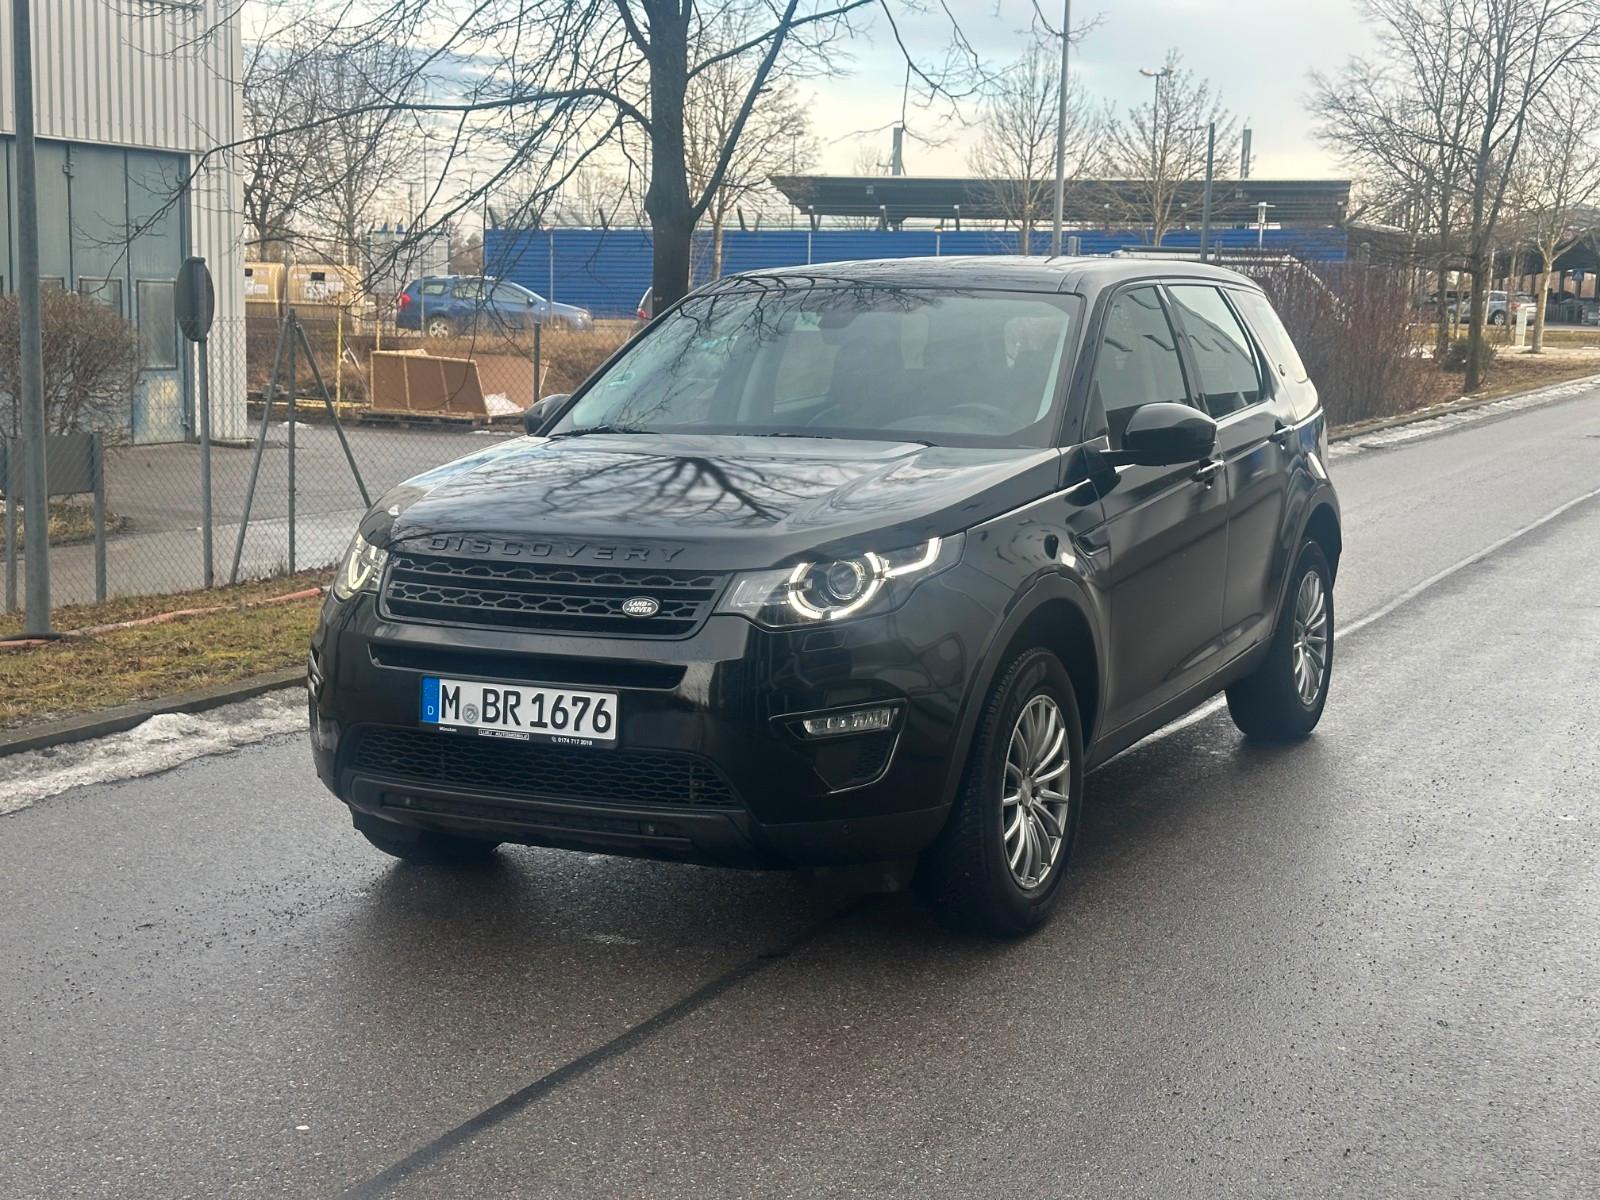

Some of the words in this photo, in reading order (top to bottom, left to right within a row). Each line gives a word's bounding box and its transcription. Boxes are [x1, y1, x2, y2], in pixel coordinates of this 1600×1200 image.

[428, 537, 686, 562] DISCOVERY
[427, 705, 434, 716] D
[441, 684, 461, 720] M
[481, 687, 522, 727] BR
[529, 692, 612, 734] 1676
